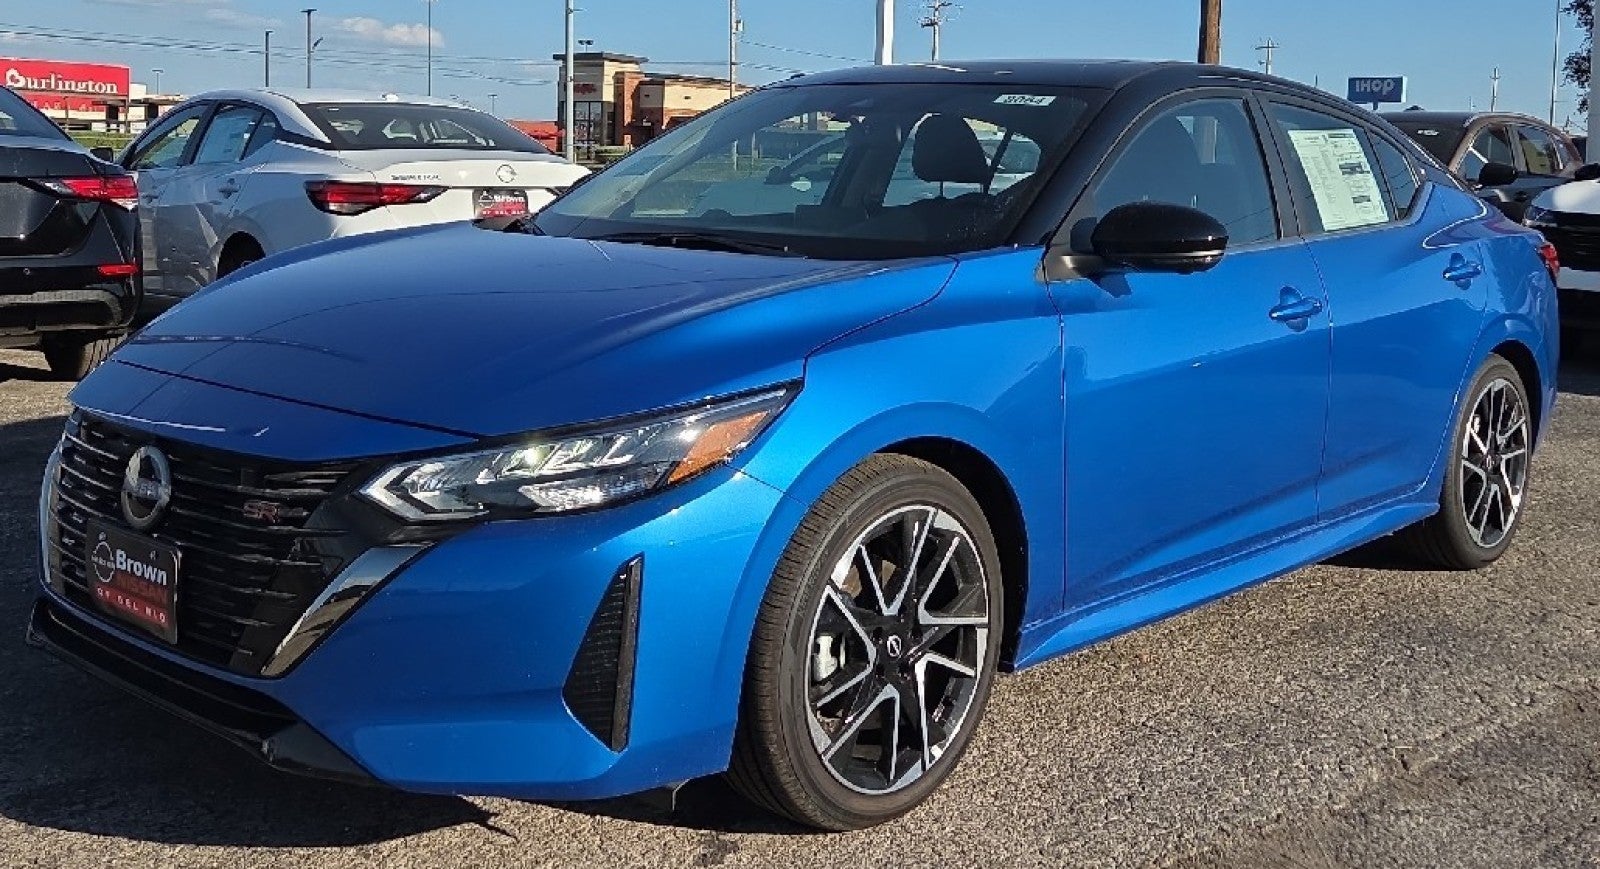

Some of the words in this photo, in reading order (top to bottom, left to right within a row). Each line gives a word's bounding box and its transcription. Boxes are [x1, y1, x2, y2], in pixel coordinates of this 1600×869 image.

[5, 68, 118, 93] Burlington
[116, 548, 167, 586] Brown
[117, 595, 139, 611] DEL
